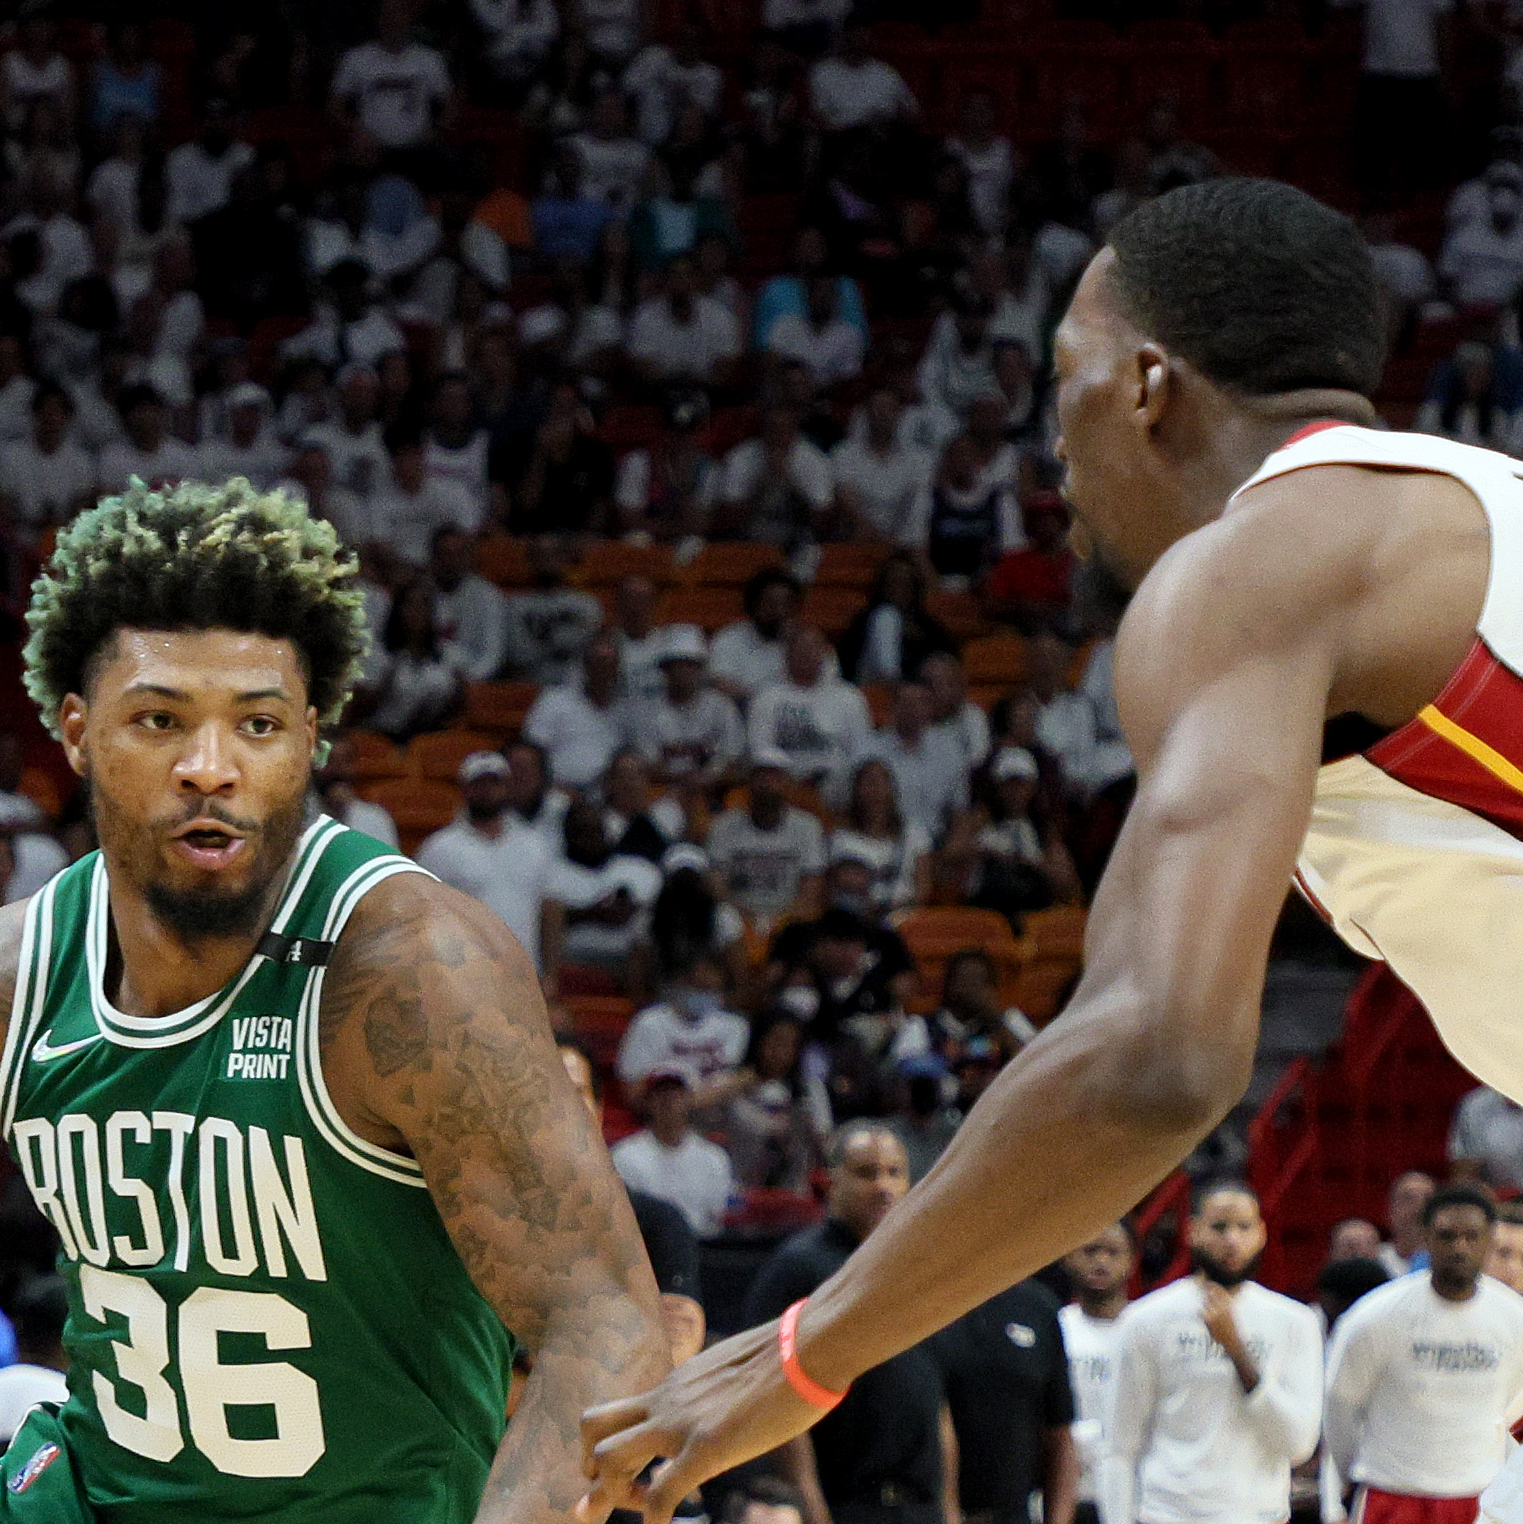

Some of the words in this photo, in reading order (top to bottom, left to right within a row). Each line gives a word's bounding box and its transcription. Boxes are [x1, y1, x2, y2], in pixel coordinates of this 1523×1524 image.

[226, 1053, 291, 1081] PRINT
[231, 1015, 293, 1053] VISTA
[14, 1110, 328, 1282] BOSTON
[79, 1263, 327, 1478] 36
